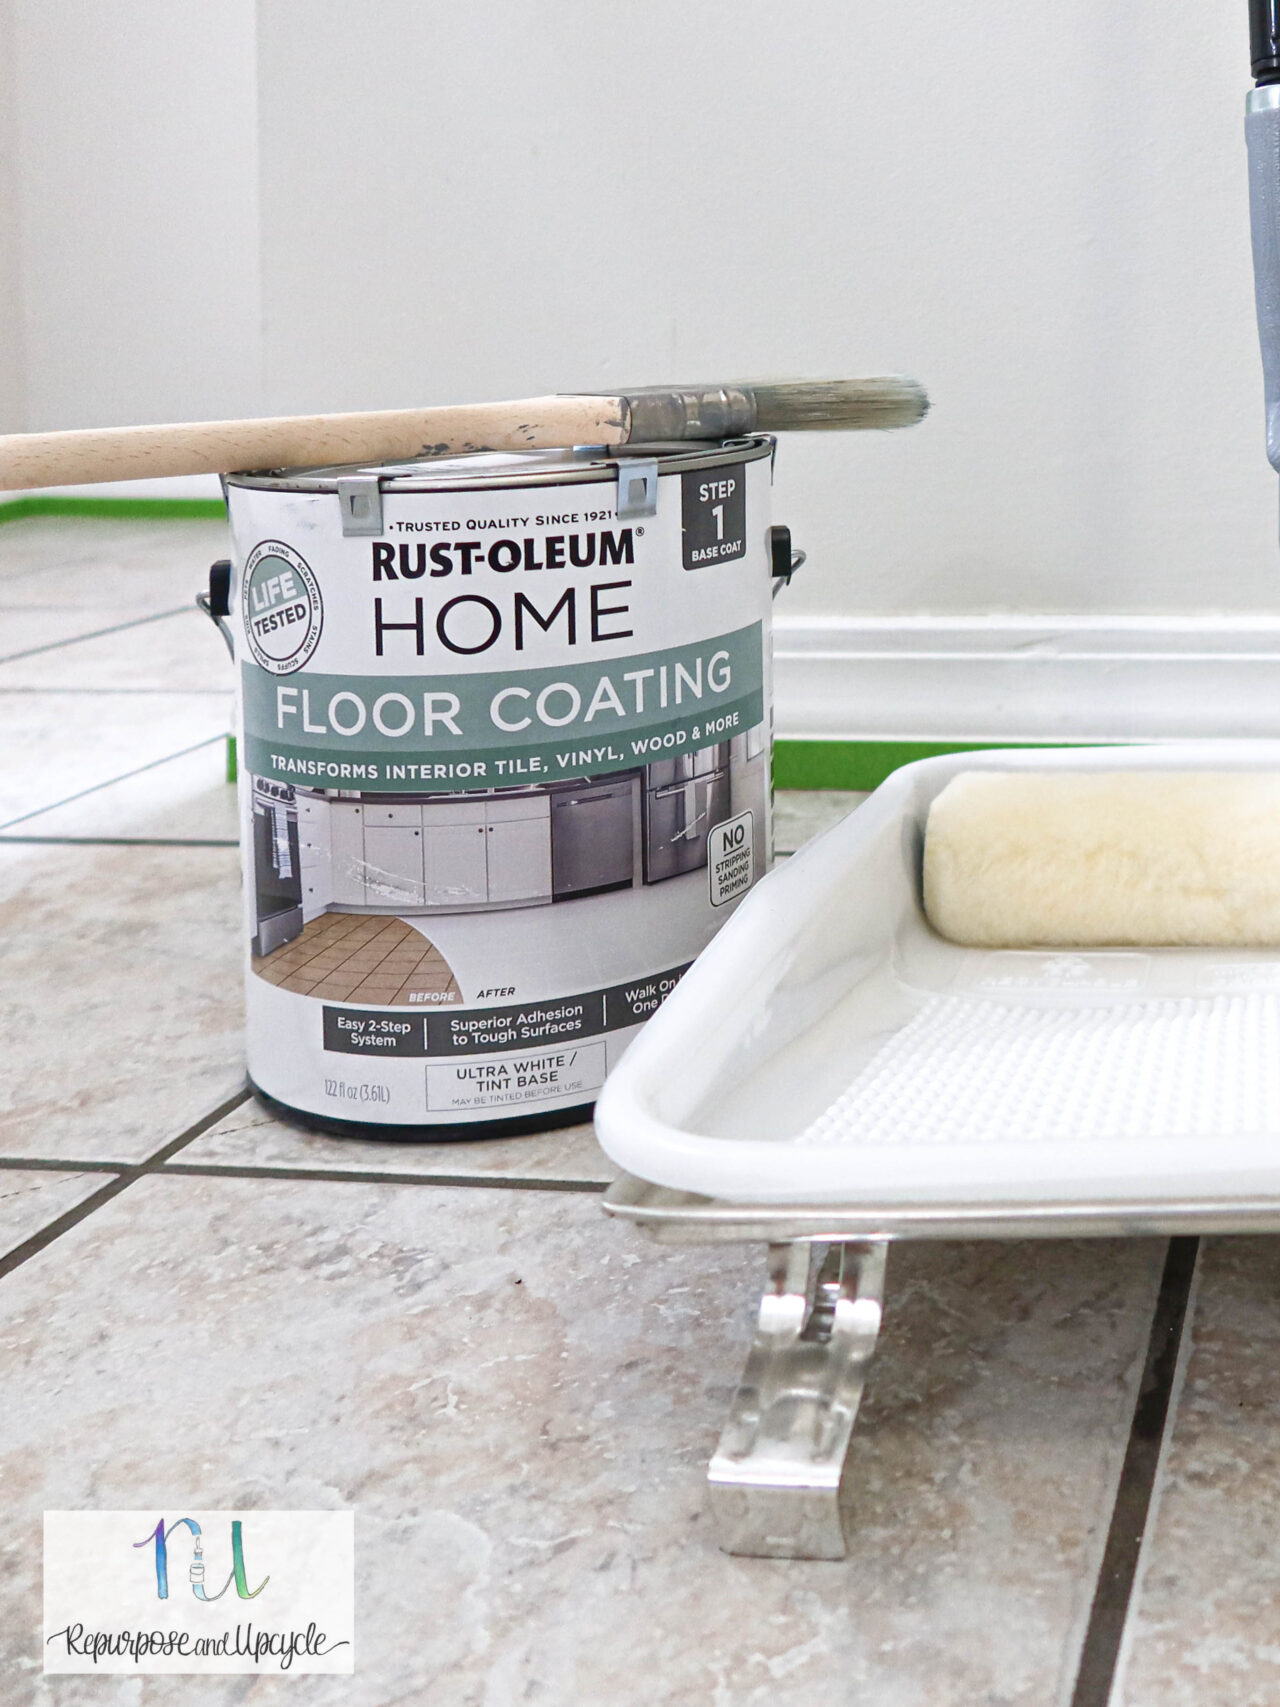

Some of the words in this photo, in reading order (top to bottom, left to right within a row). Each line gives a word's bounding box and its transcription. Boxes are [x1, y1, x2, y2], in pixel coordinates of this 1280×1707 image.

[700, 479, 736, 502] STEP
[396, 521, 461, 532] TRUSTED
[466, 517, 530, 531] QUALITY
[535, 513, 579, 527] SINCE
[584, 510, 612, 522] 1921
[712, 504, 724, 540] 1
[268, 545, 290, 558] FADING
[691, 546, 719, 562] BASE
[720, 540, 742, 555] COAT
[251, 570, 298, 612] LIFE
[296, 562, 319, 612] SCRATCHES
[253, 603, 307, 637] TESTED
[374, 580, 634, 656] HOME
[303, 625, 318, 655] STAINS
[277, 657, 299, 671] SCUFFS
[277, 686, 464, 737] FLOOR
[489, 650, 732, 732] COATING
[270, 754, 379, 780] TRANSFORMS
[386, 762, 487, 780] INTERIOR
[495, 756, 549, 774] TILE,
[556, 745, 625, 768] VINYL,
[631, 730, 687, 755] WOOD
[691, 726, 701, 740] &
[705, 711, 740, 737] MORE
[723, 824, 745, 852] NO
[715, 847, 751, 874] STRIPPING
[718, 860, 749, 886] SANDING
[719, 873, 749, 897] PRIMING
[409, 992, 455, 1003] BEFORE
[477, 986, 516, 999] AFTER
[625, 984, 657, 1003] Walk
[659, 979, 676, 992] On
[450, 1016, 513, 1033] Superior
[516, 1005, 583, 1026] Adhesion
[632, 999, 658, 1014] One
[337, 1016, 366, 1032] Easy
[368, 1019, 412, 1036] 2-Step
[452, 1033, 468, 1046] to
[472, 1028, 517, 1045] Tough
[520, 1018, 582, 1039] Surfaces
[350, 1032, 397, 1047] System
[456, 1065, 508, 1080] ULTRA
[514, 1055, 566, 1074] WHITE
[325, 1079, 338, 1097] 122
[347, 1086, 358, 1100] oz
[452, 1097, 472, 1106] MAY
[474, 1097, 487, 1105] BE
[489, 1092, 523, 1103] TINTED
[524, 1086, 562, 1098] BEFORE
[564, 1080, 583, 1090] USE
[476, 1078, 511, 1092] TINT
[517, 1070, 559, 1088] BASE
